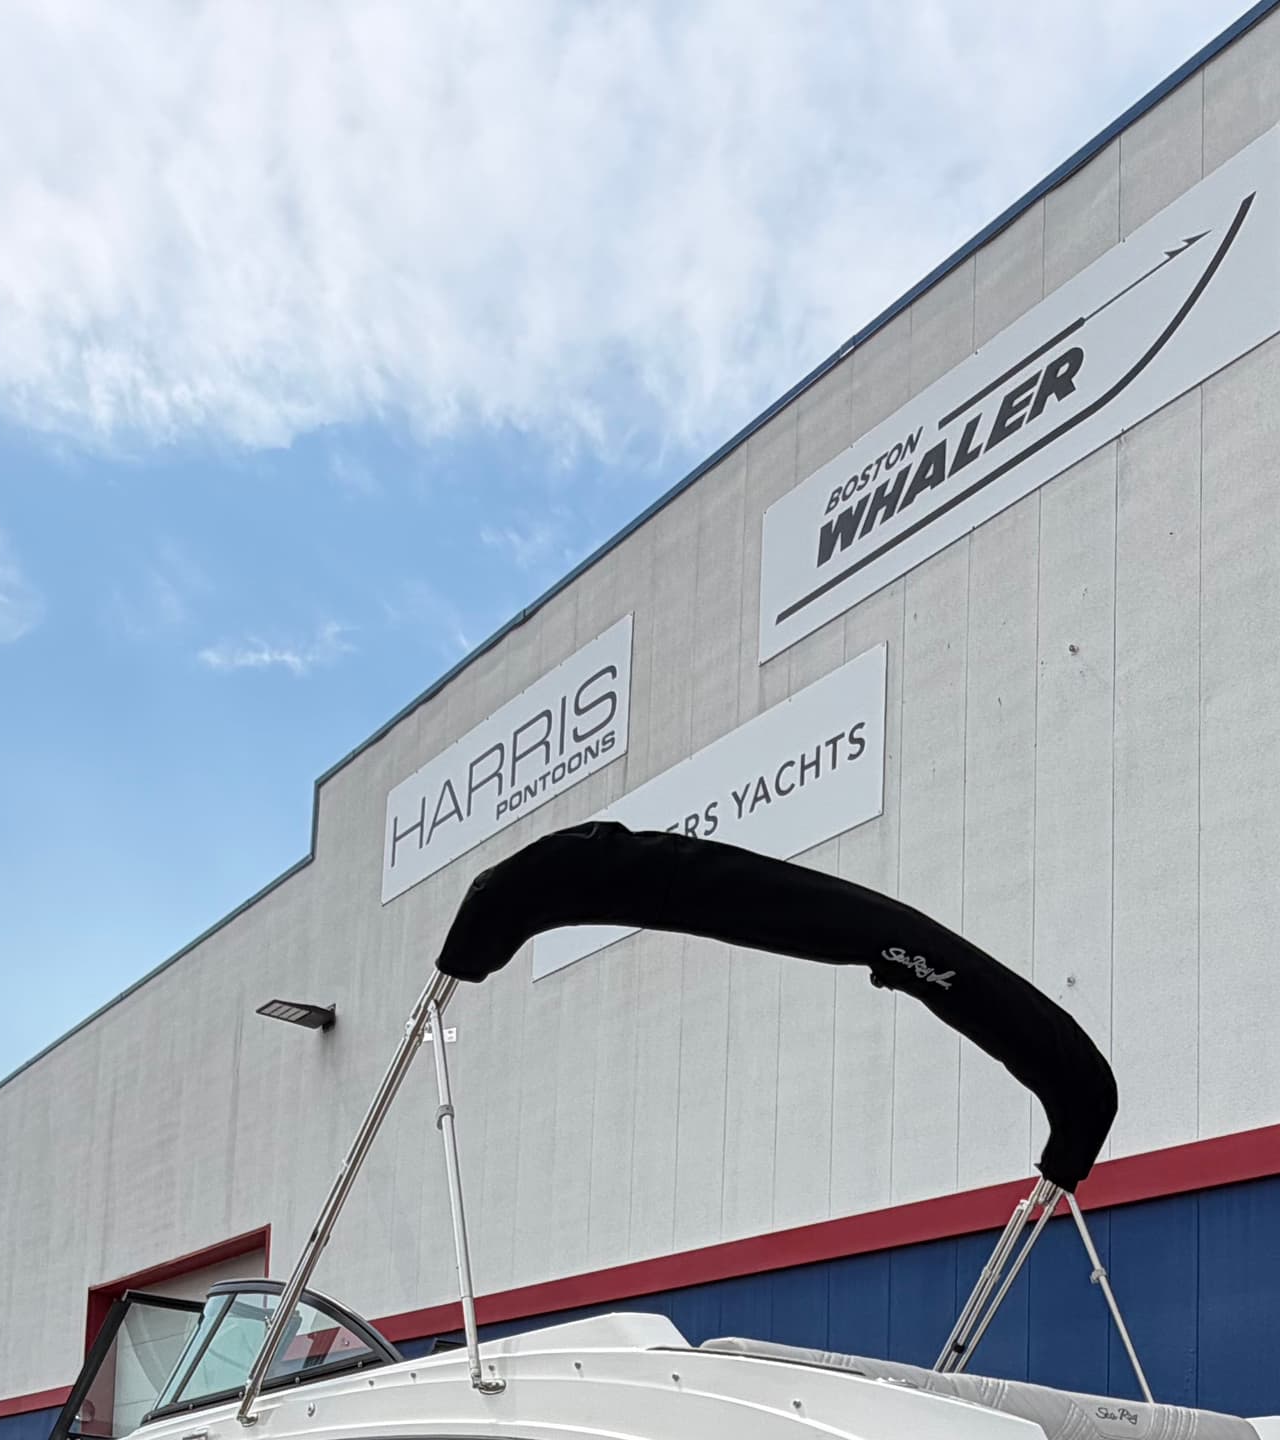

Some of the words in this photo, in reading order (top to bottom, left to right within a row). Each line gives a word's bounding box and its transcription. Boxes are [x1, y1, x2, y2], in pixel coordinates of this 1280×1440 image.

[817, 346, 1084, 569] WHALER
[824, 426, 923, 517] BOSTON
[391, 664, 618, 868] HARRIS
[496, 732, 616, 820] PONTOONS
[731, 722, 867, 820] YACHTS
[1095, 1406, 1117, 1420] Sea
[1118, 1407, 1138, 1425] Ray
